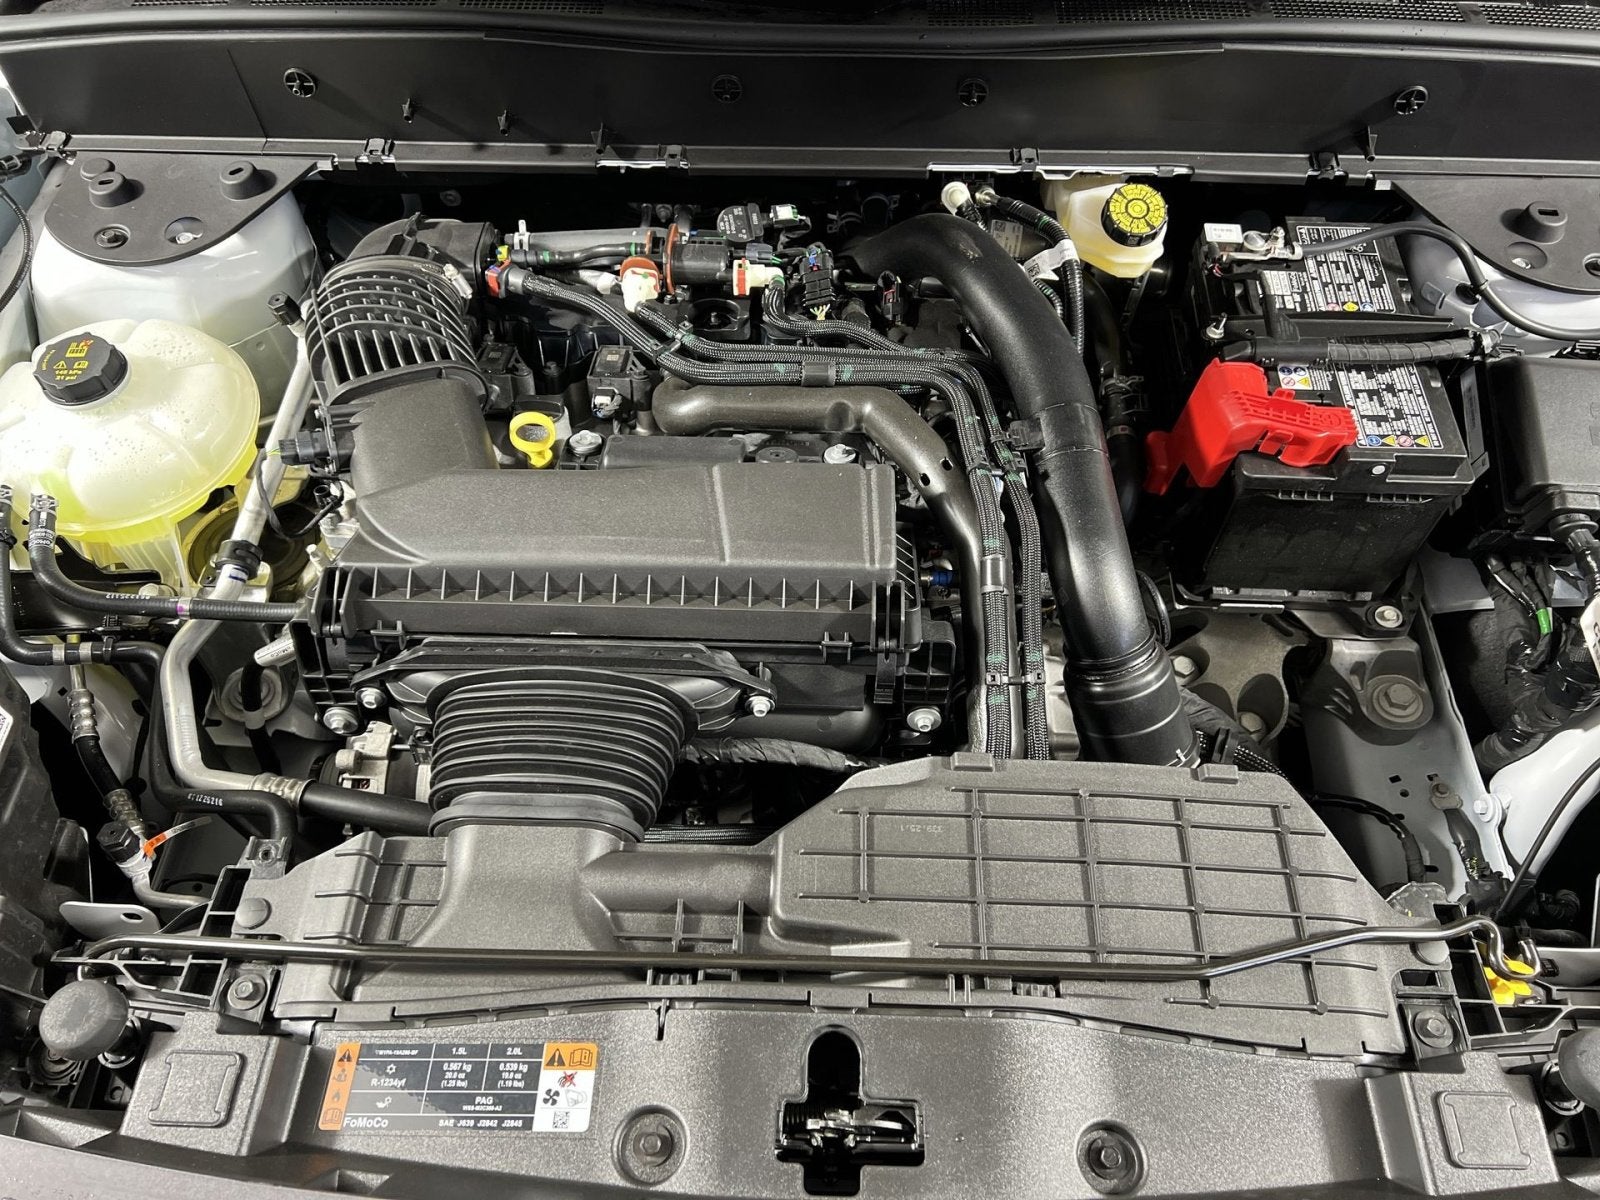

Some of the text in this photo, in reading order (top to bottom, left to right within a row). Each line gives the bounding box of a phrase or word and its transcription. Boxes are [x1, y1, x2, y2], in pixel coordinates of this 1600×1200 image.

[452, 1047, 467, 1055] 1.5L
[462, 1062, 472, 1073] kg
[519, 1062, 528, 1073] kg
[371, 1078, 407, 1088] R-1234yf
[475, 1096, 494, 1105] PAG
[343, 1117, 388, 1128] FoMoCo
[438, 1119, 455, 1127] SAE
